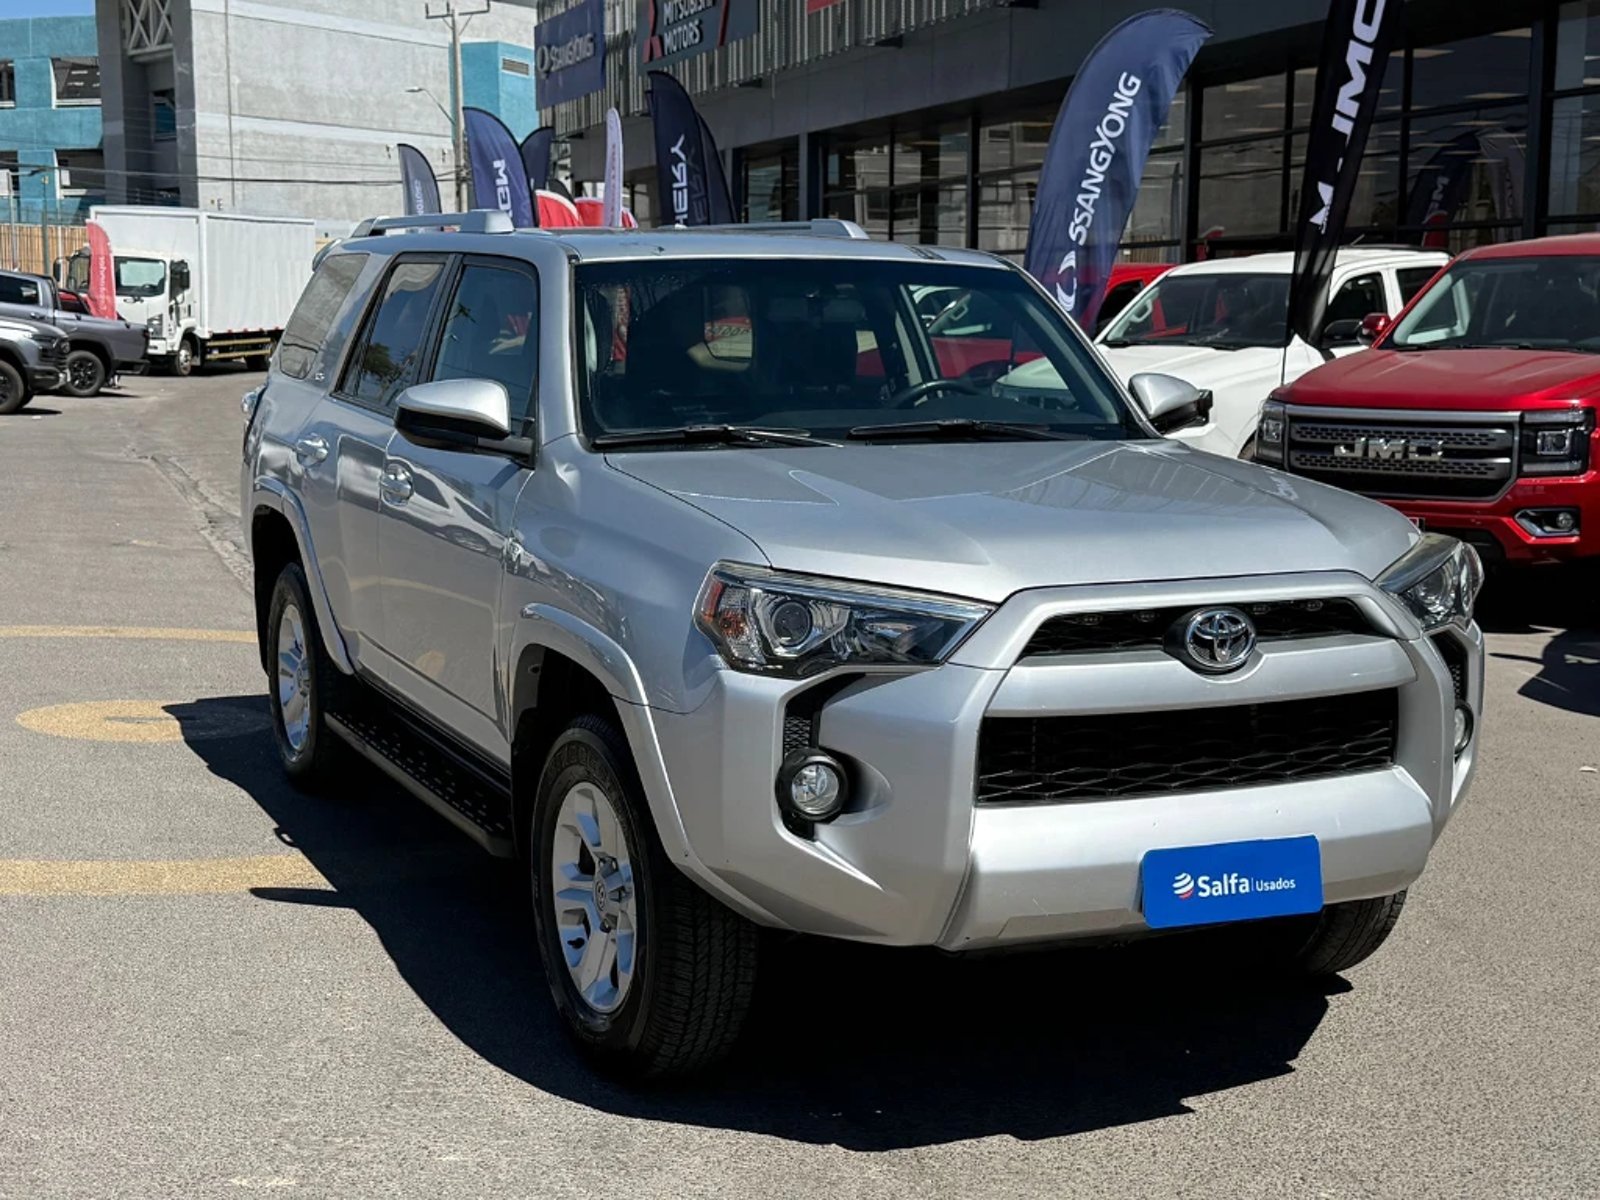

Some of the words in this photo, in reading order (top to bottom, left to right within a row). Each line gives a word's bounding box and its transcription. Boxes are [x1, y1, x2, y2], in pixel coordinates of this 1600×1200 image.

[664, 0, 713, 26] MITSUBI
[664, 20, 700, 56] MOTORS
[1069, 71, 1142, 246] SSANGYONG
[1334, 437, 1443, 461] JMC
[1198, 873, 1250, 897] Salfa
[1255, 877, 1296, 892] Usados
